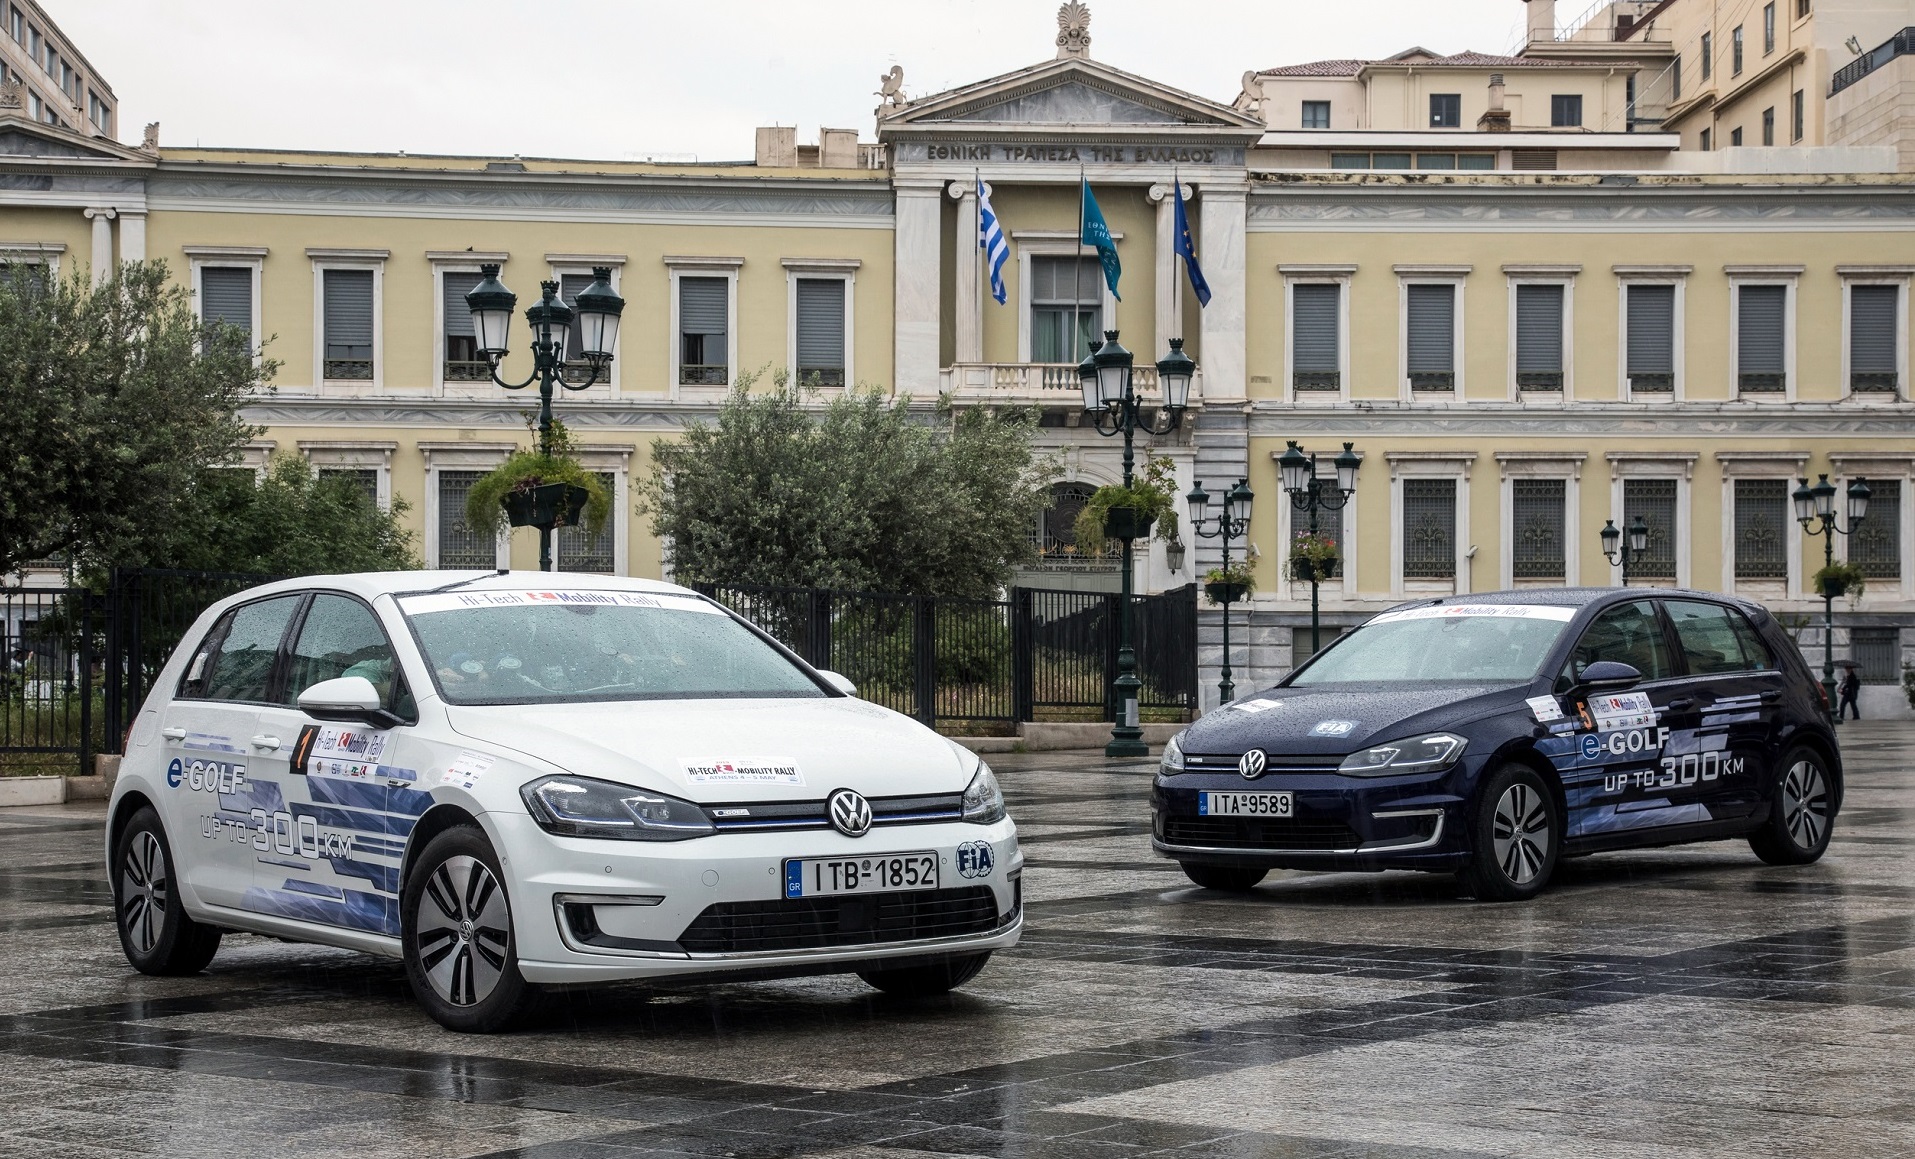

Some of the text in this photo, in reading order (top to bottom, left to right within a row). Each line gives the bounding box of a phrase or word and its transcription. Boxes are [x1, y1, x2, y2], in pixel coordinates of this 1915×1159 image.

[927, 144, 1214, 163] ΕΘΝΙΚΗ ΤΡΑΠΕΖΑ ΤΗΣ ΕΛΛΑΔΟΣ
[458, 592, 663, 608] Hi-Tech Mobility Rally
[1576, 701, 1593, 730] 5
[297, 728, 313, 769] 1
[1581, 726, 1670, 760] e-GOLF
[167, 757, 246, 795] e-GOLF
[687, 767, 719, 775] HI-TECH
[774, 767, 796, 776] RALLY
[1604, 751, 1744, 792] UP TO 300 KM
[201, 808, 353, 860] UP TO 300 KM
[789, 883, 801, 891] GR
